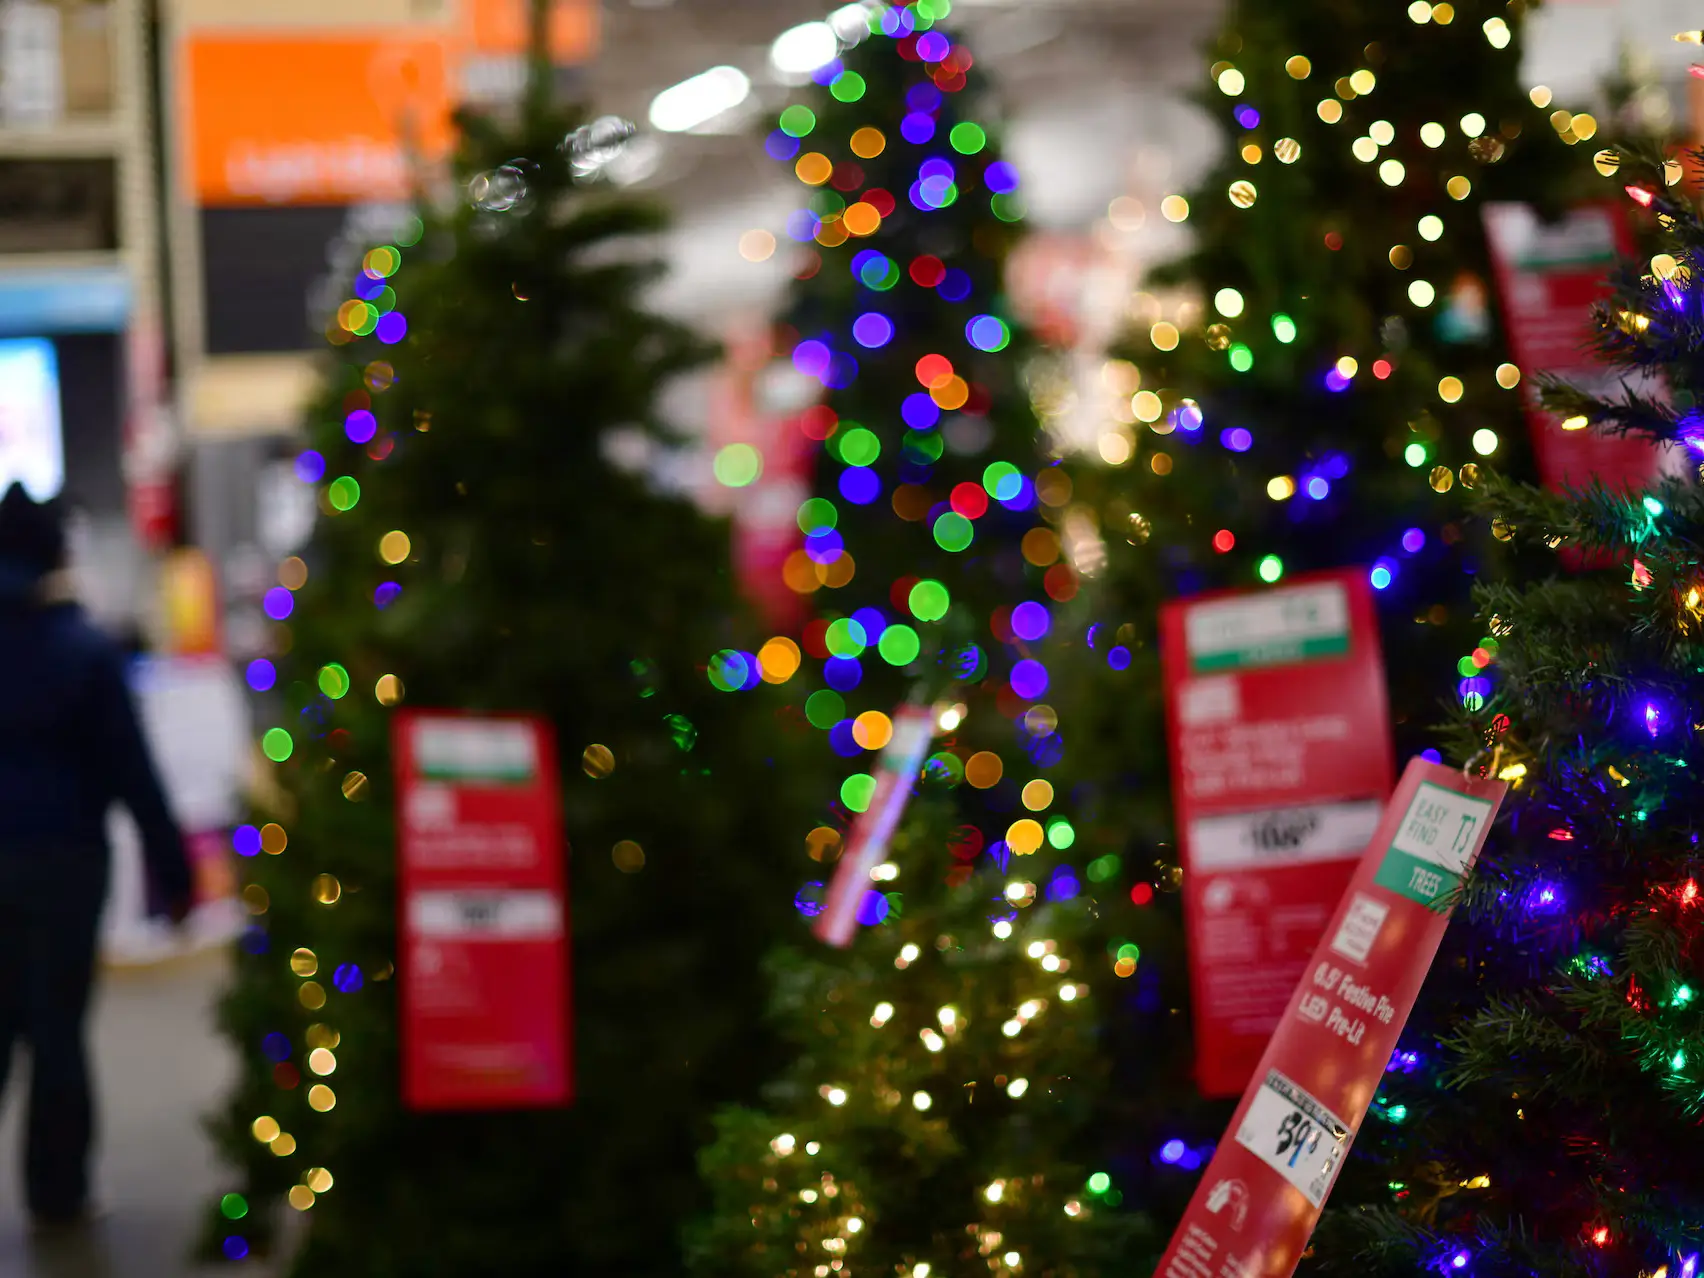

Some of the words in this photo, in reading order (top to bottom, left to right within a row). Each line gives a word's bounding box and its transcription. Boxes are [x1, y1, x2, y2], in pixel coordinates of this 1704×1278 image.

[1415, 798, 1449, 825] EASY
[1407, 820, 1439, 846] FIND
[1408, 866, 1443, 897] TREES
[1299, 991, 1329, 1022] LED
